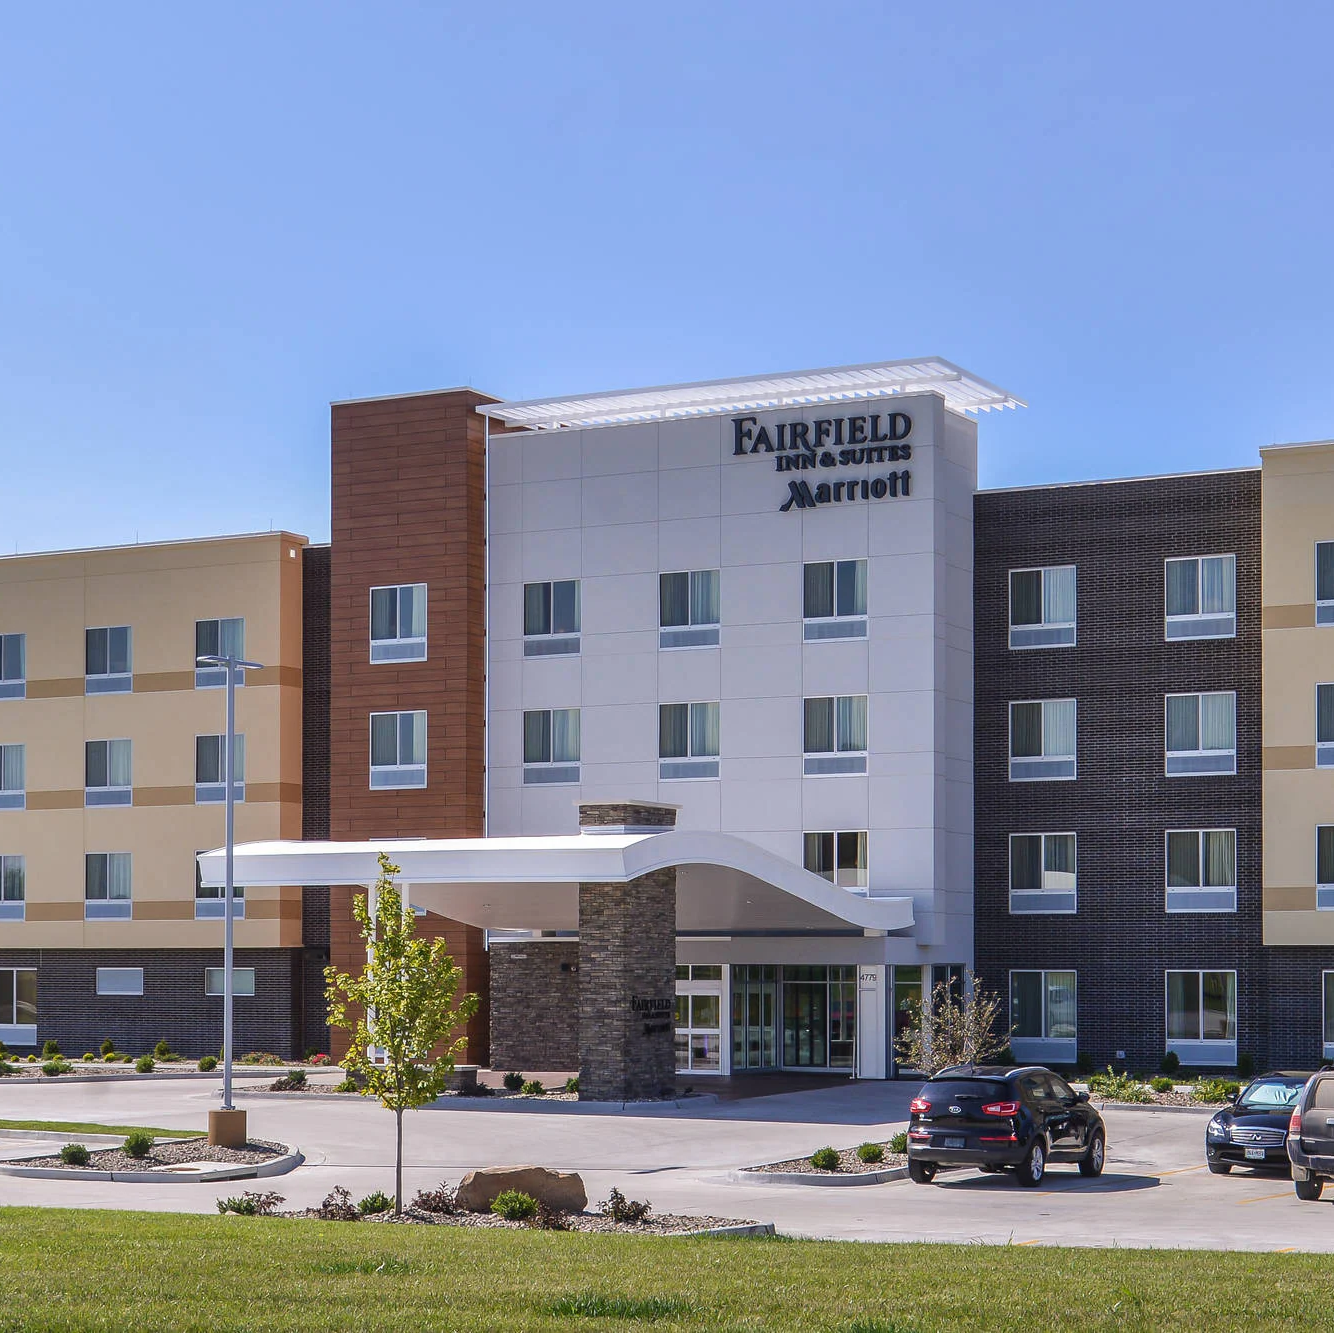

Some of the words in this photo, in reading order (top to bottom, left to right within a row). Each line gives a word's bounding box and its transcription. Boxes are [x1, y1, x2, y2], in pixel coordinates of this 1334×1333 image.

[731, 412, 912, 455] FAIRFIELD
[775, 453, 817, 472] INN
[819, 451, 837, 467] &
[839, 444, 912, 466] SUITES
[779, 469, 911, 512] Marriott
[860, 973, 877, 982] 4779
